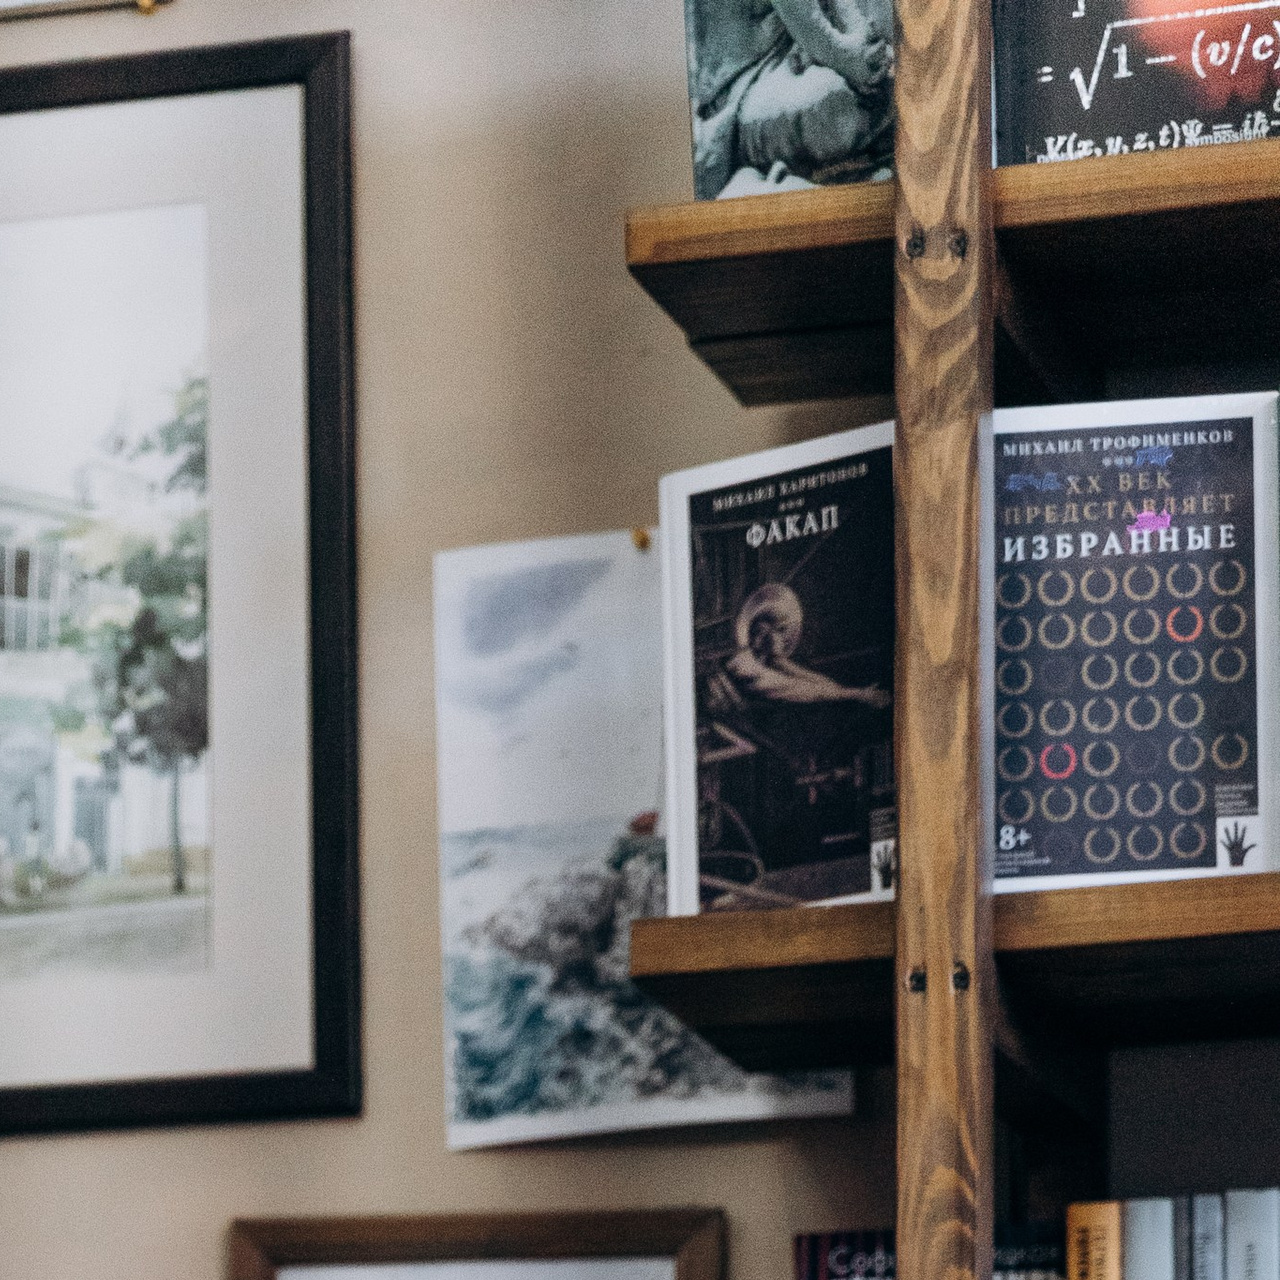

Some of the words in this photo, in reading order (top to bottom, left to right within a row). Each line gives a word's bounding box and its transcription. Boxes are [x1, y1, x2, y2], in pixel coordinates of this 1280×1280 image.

[1003, 438, 1082, 457] МИХАИЛ
[1089, 429, 1234, 451] ТРОФИМЕНКОВ
[1119, 470, 1172, 492] ВЕК
[745, 503, 840, 549] ФАКАП
[1004, 493, 1236, 526] ПРЕДСТАВЛЯЕТ
[1003, 523, 1237, 563] ИЗБРАННЫЕ
